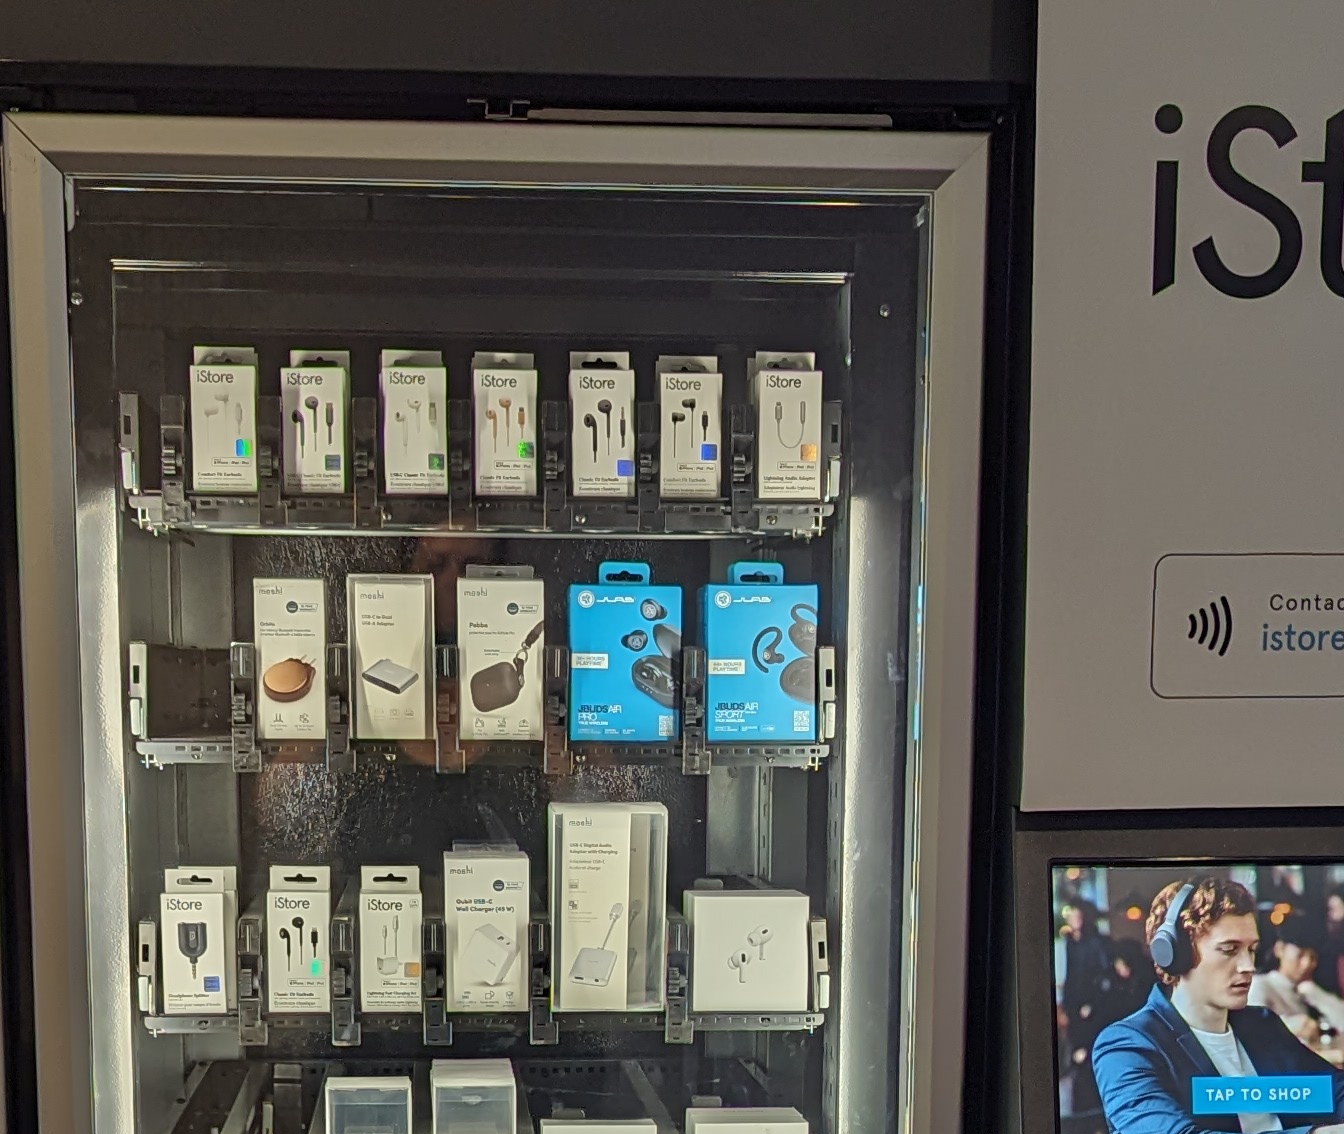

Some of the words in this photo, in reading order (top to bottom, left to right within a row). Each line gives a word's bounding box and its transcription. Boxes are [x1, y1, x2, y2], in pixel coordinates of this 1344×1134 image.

[196, 370, 234, 384] iStore
[286, 372, 323, 386] iStore
[389, 371, 426, 385] iStore
[481, 375, 517, 388] iStore
[578, 376, 616, 390] iStore
[765, 375, 802, 389] iStore
[665, 377, 702, 391] iStore
[258, 585, 283, 595] moshi
[360, 589, 385, 600] moshi
[463, 587, 488, 597] moshi
[577, 712, 598, 722] PRO
[714, 710, 745, 720] SPORT
[568, 817, 593, 827] moshi
[449, 865, 473, 876] moshi
[166, 899, 203, 911] iStore
[274, 897, 310, 910] iStore
[367, 898, 403, 911] iStore
[1206, 1088, 1234, 1101] TAP
[1241, 1088, 1262, 1101] TO
[1268, 1087, 1311, 1101] SHOP
